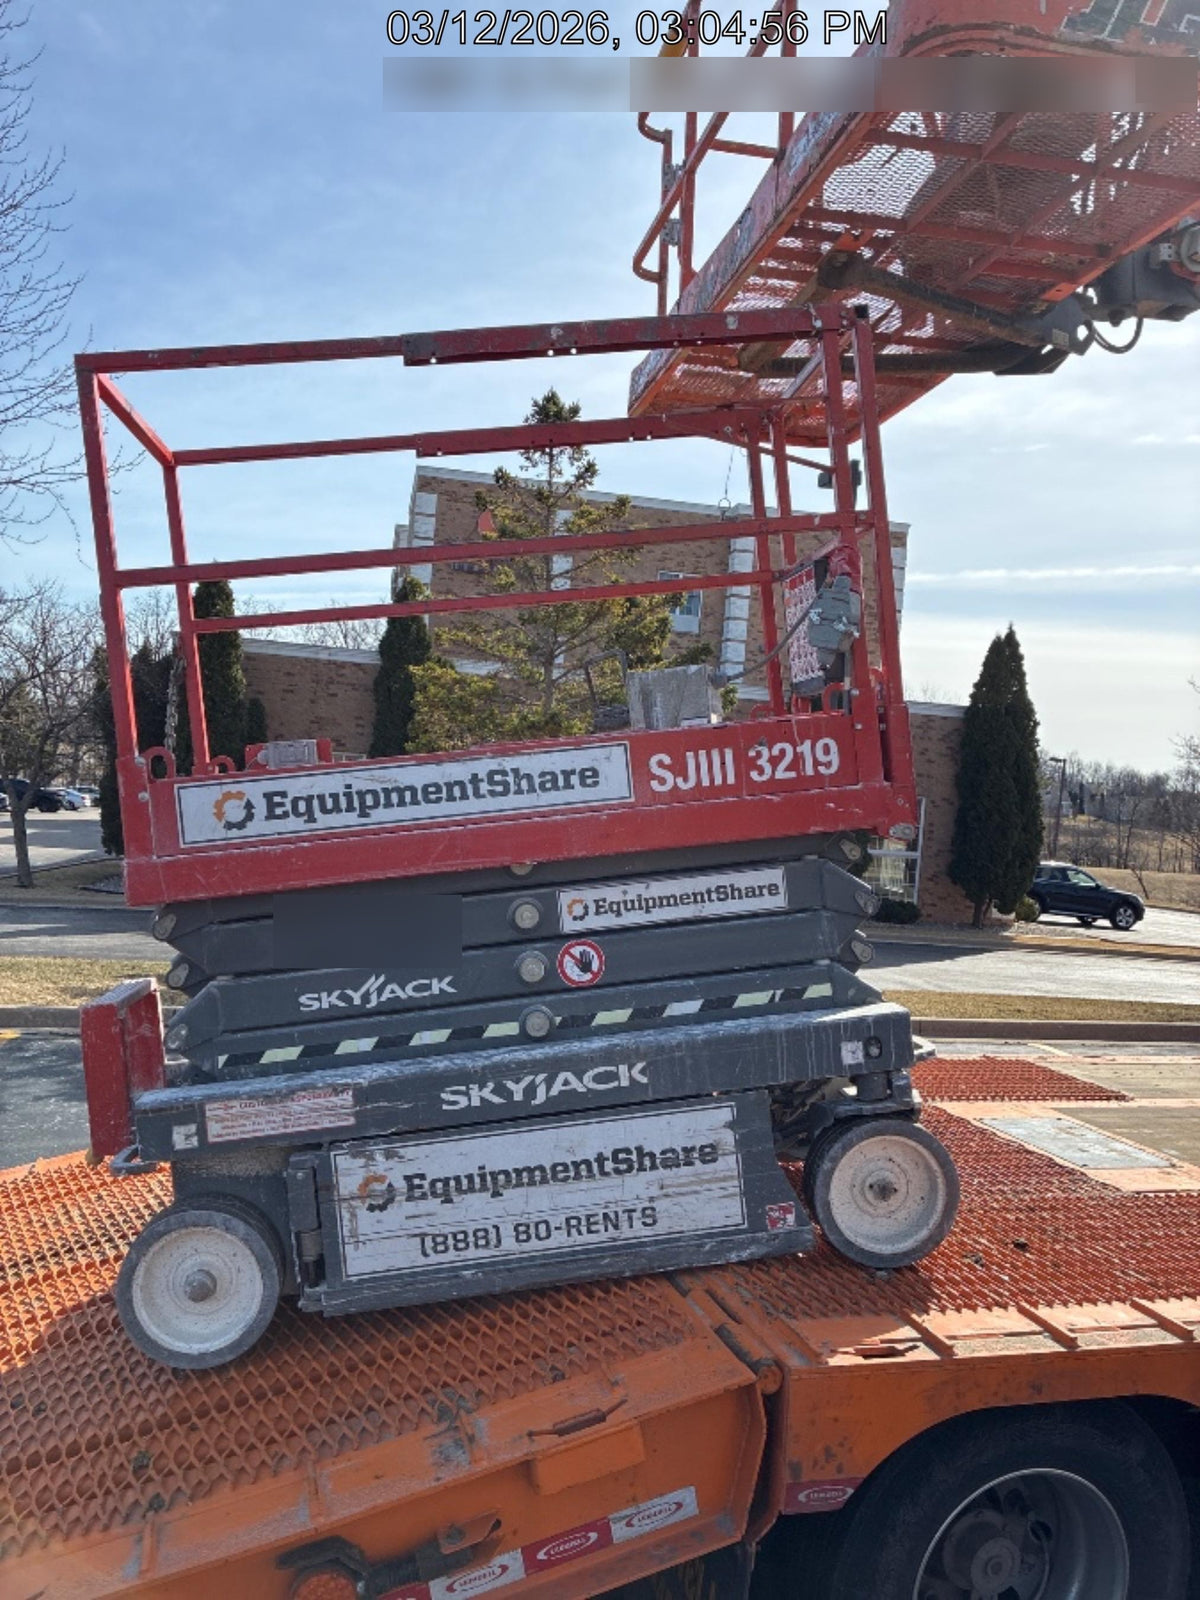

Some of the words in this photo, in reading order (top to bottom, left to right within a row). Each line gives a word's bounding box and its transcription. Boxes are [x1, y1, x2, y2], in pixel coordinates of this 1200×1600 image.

[648, 747, 735, 791] SJIII
[748, 736, 840, 783] 3219
[263, 766, 599, 823] EquipmentShare
[594, 883, 780, 915] EquipmentShare
[299, 974, 457, 1012] SKYJACK
[440, 1062, 649, 1110] SKYJACK
[403, 1142, 719, 1204] EquipmentShare
[514, 1206, 658, 1243] 80-RENTS
